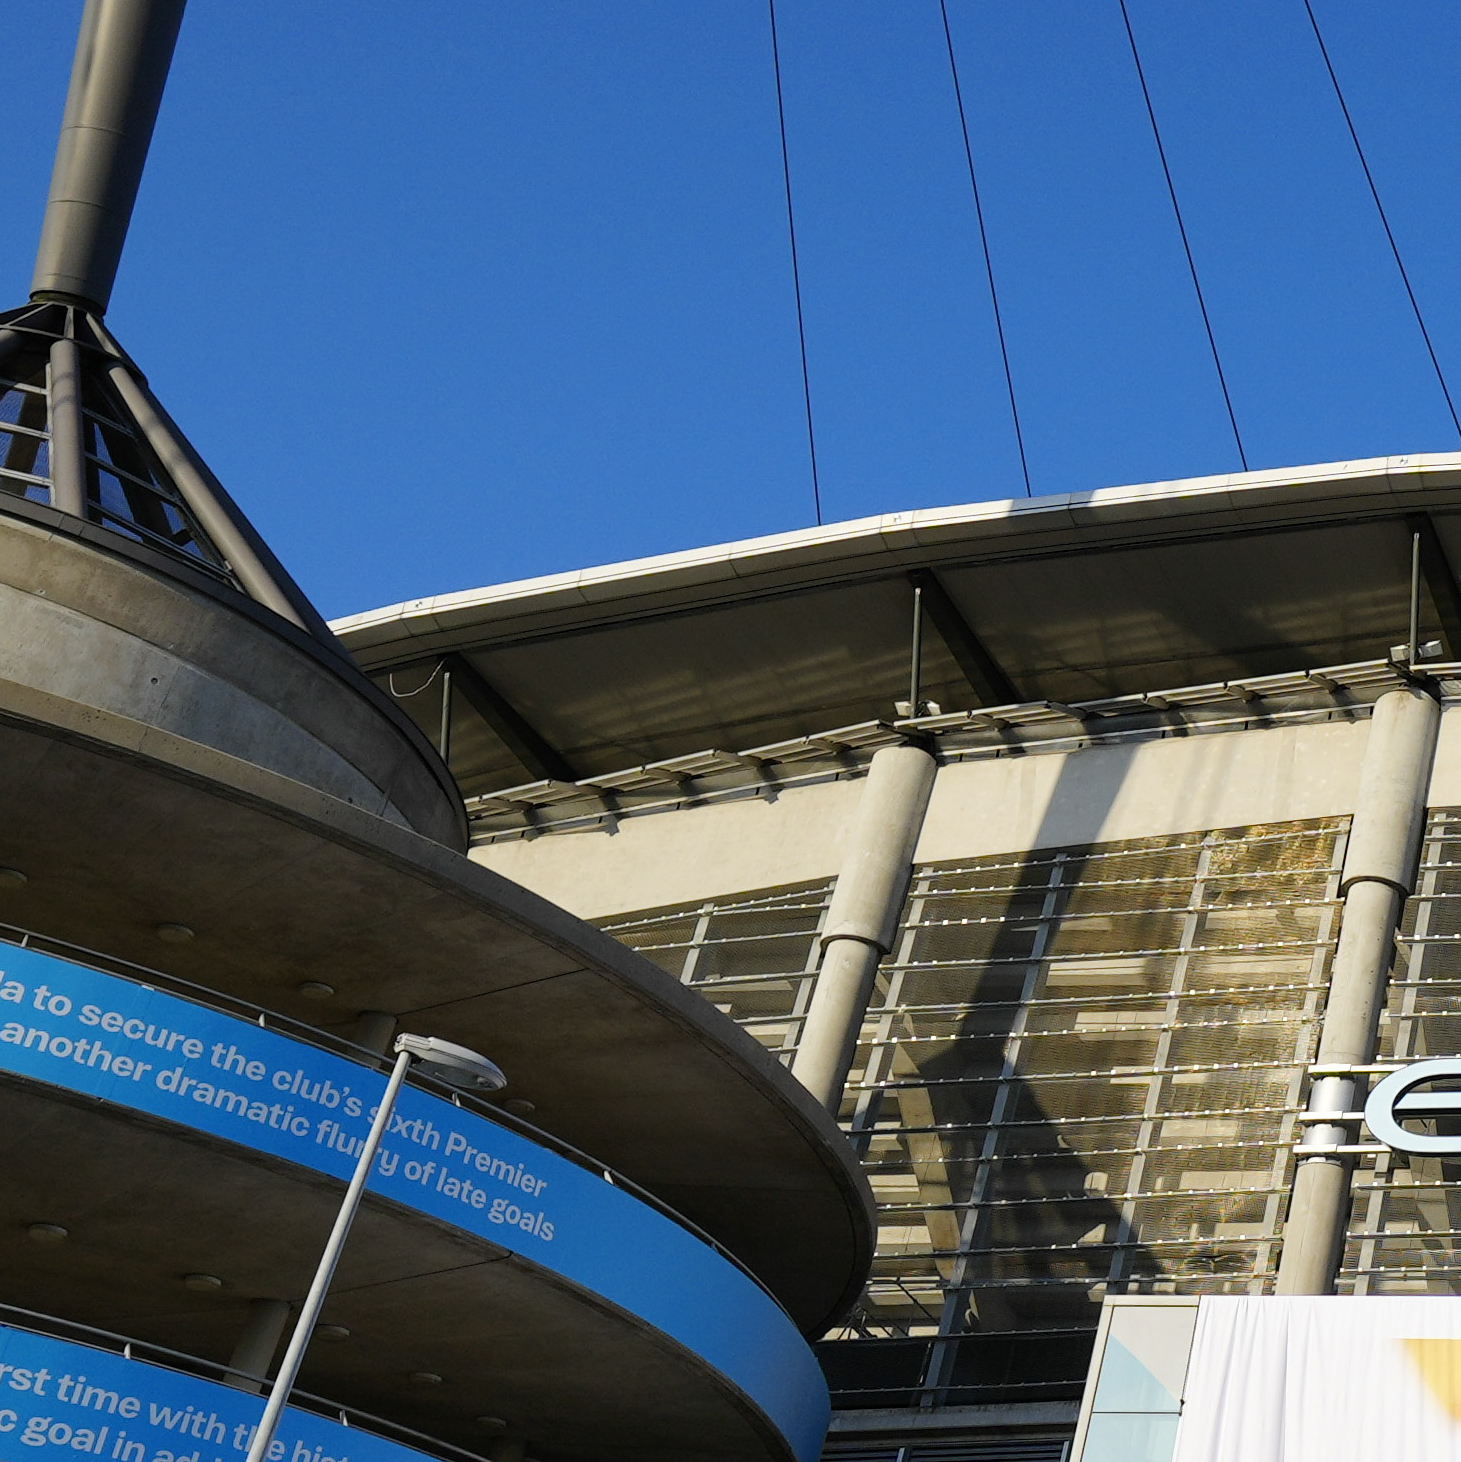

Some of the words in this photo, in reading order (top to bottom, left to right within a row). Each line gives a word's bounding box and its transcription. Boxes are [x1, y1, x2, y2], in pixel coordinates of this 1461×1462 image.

[0, 1021, 152, 1082] another
[155, 1066, 310, 1137] dramatic
[404, 1159, 437, 1186] of
[436, 1166, 487, 1209] late
[487, 1197, 555, 1242] goals
[34, 985, 72, 1016] to
[78, 1004, 204, 1058] secure
[211, 1042, 266, 1081] the
[366, 1105, 440, 1151] sixth
[444, 1131, 548, 1198] Premier
[0, 1363, 51, 1397] rst
[57, 1374, 141, 1419] time
[150, 1402, 227, 1445] with
[20, 1416, 110, 1455] goal
